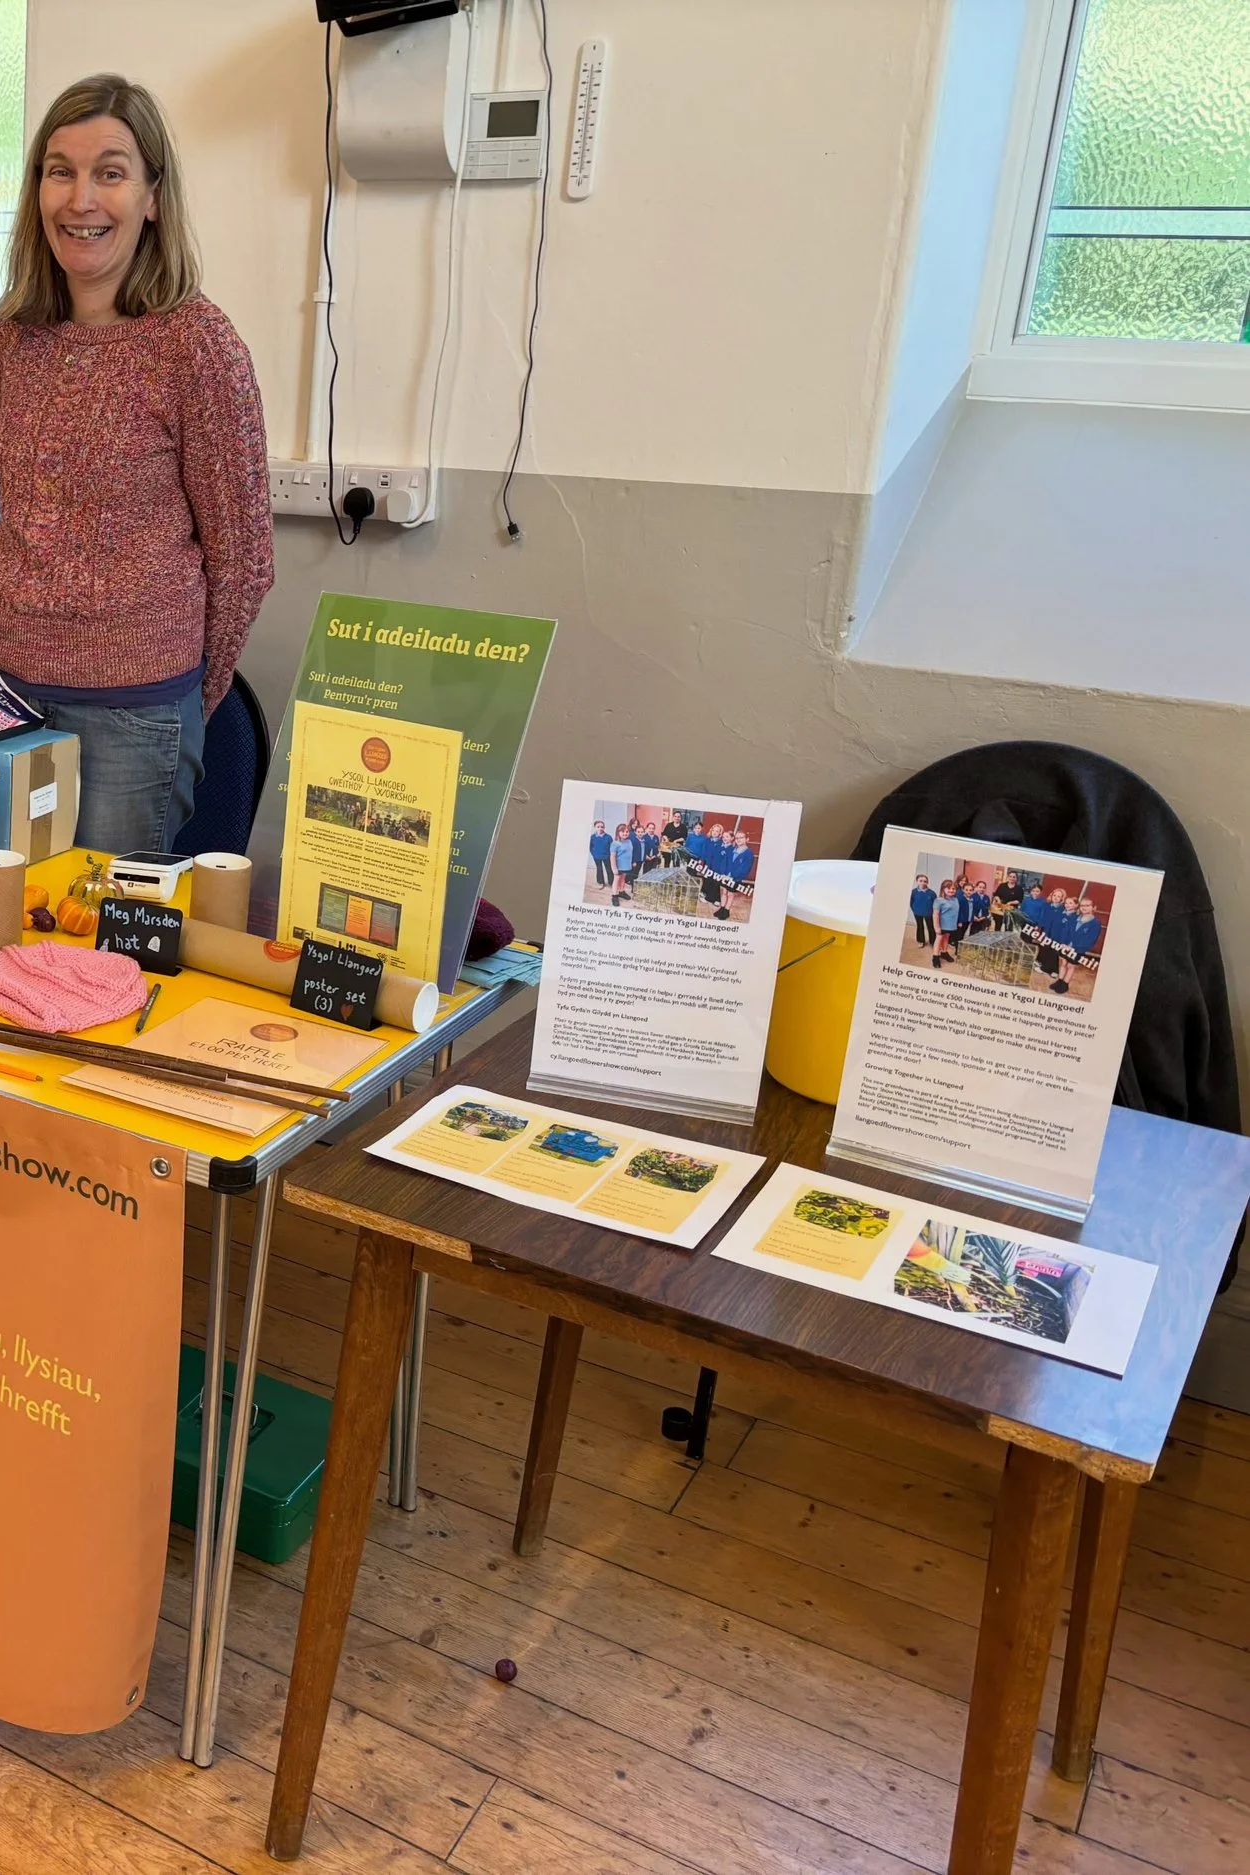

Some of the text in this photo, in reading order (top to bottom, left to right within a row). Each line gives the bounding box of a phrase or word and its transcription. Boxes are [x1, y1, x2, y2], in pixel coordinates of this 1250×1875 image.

[328, 619, 530, 663] Sut i adeiladu den?
[309, 671, 403, 694] Sut i adeiladu den?
[324, 689, 398, 710] Pentyru'r pren
[463, 739, 490, 753] den?
[329, 777, 362, 792] GWEITHDY
[374, 788, 417, 803] WORKSHOP
[342, 771, 406, 792] YSGOL LLANGOED
[459, 771, 485, 786] igau.
[687, 858, 735, 892] Helpwch
[105, 903, 180, 929] Meg Marsden
[567, 904, 602, 915] Helpwch
[604, 909, 622, 918] Tyfu
[635, 912, 662, 924] Gwydr
[675, 918, 697, 928] Ysgol
[699, 921, 739, 934] Llangoed!
[116, 933, 140, 950] hat
[1021, 924, 1099, 971] Helpwch ni!
[308, 944, 333, 963] Ysgol
[338, 954, 382, 976] Llangoed
[304, 978, 366, 1004] poster set
[882, 964, 904, 976] Help
[905, 970, 930, 981] Grow
[941, 977, 996, 995] Greenhouse
[998, 990, 1008, 998] at
[1010, 992, 1036, 1004] Ysgol
[1037, 998, 1084, 1015] Llangoed!
[315, 995, 332, 1013] (3)
[556, 1003, 569, 1011] Tyfu
[620, 1012, 648, 1022] Llangoed
[878, 986, 888, 994] the
[915, 994, 948, 1008] Gardening
[966, 1006, 983, 1015] Help
[992, 1011, 1010, 1021] make
[1045, 1023, 1062, 1033] piece
[1073, 1029, 1095, 1040] piece!
[875, 1001, 1077, 1052] Llangoed Flower Show (which also organises the annual Harvest
[217, 1037, 286, 1060] RAFFLE
[226, 1050, 250, 1060] PER
[252, 1057, 293, 1071] TICKET
[864, 1062, 892, 1075] Growing
[893, 1069, 923, 1082] Together
[932, 1078, 963, 1091] Llangoed
[854, 1114, 971, 1150] llangoedflowershow.com/support
[14, 1334, 101, 1403] llysiau,
